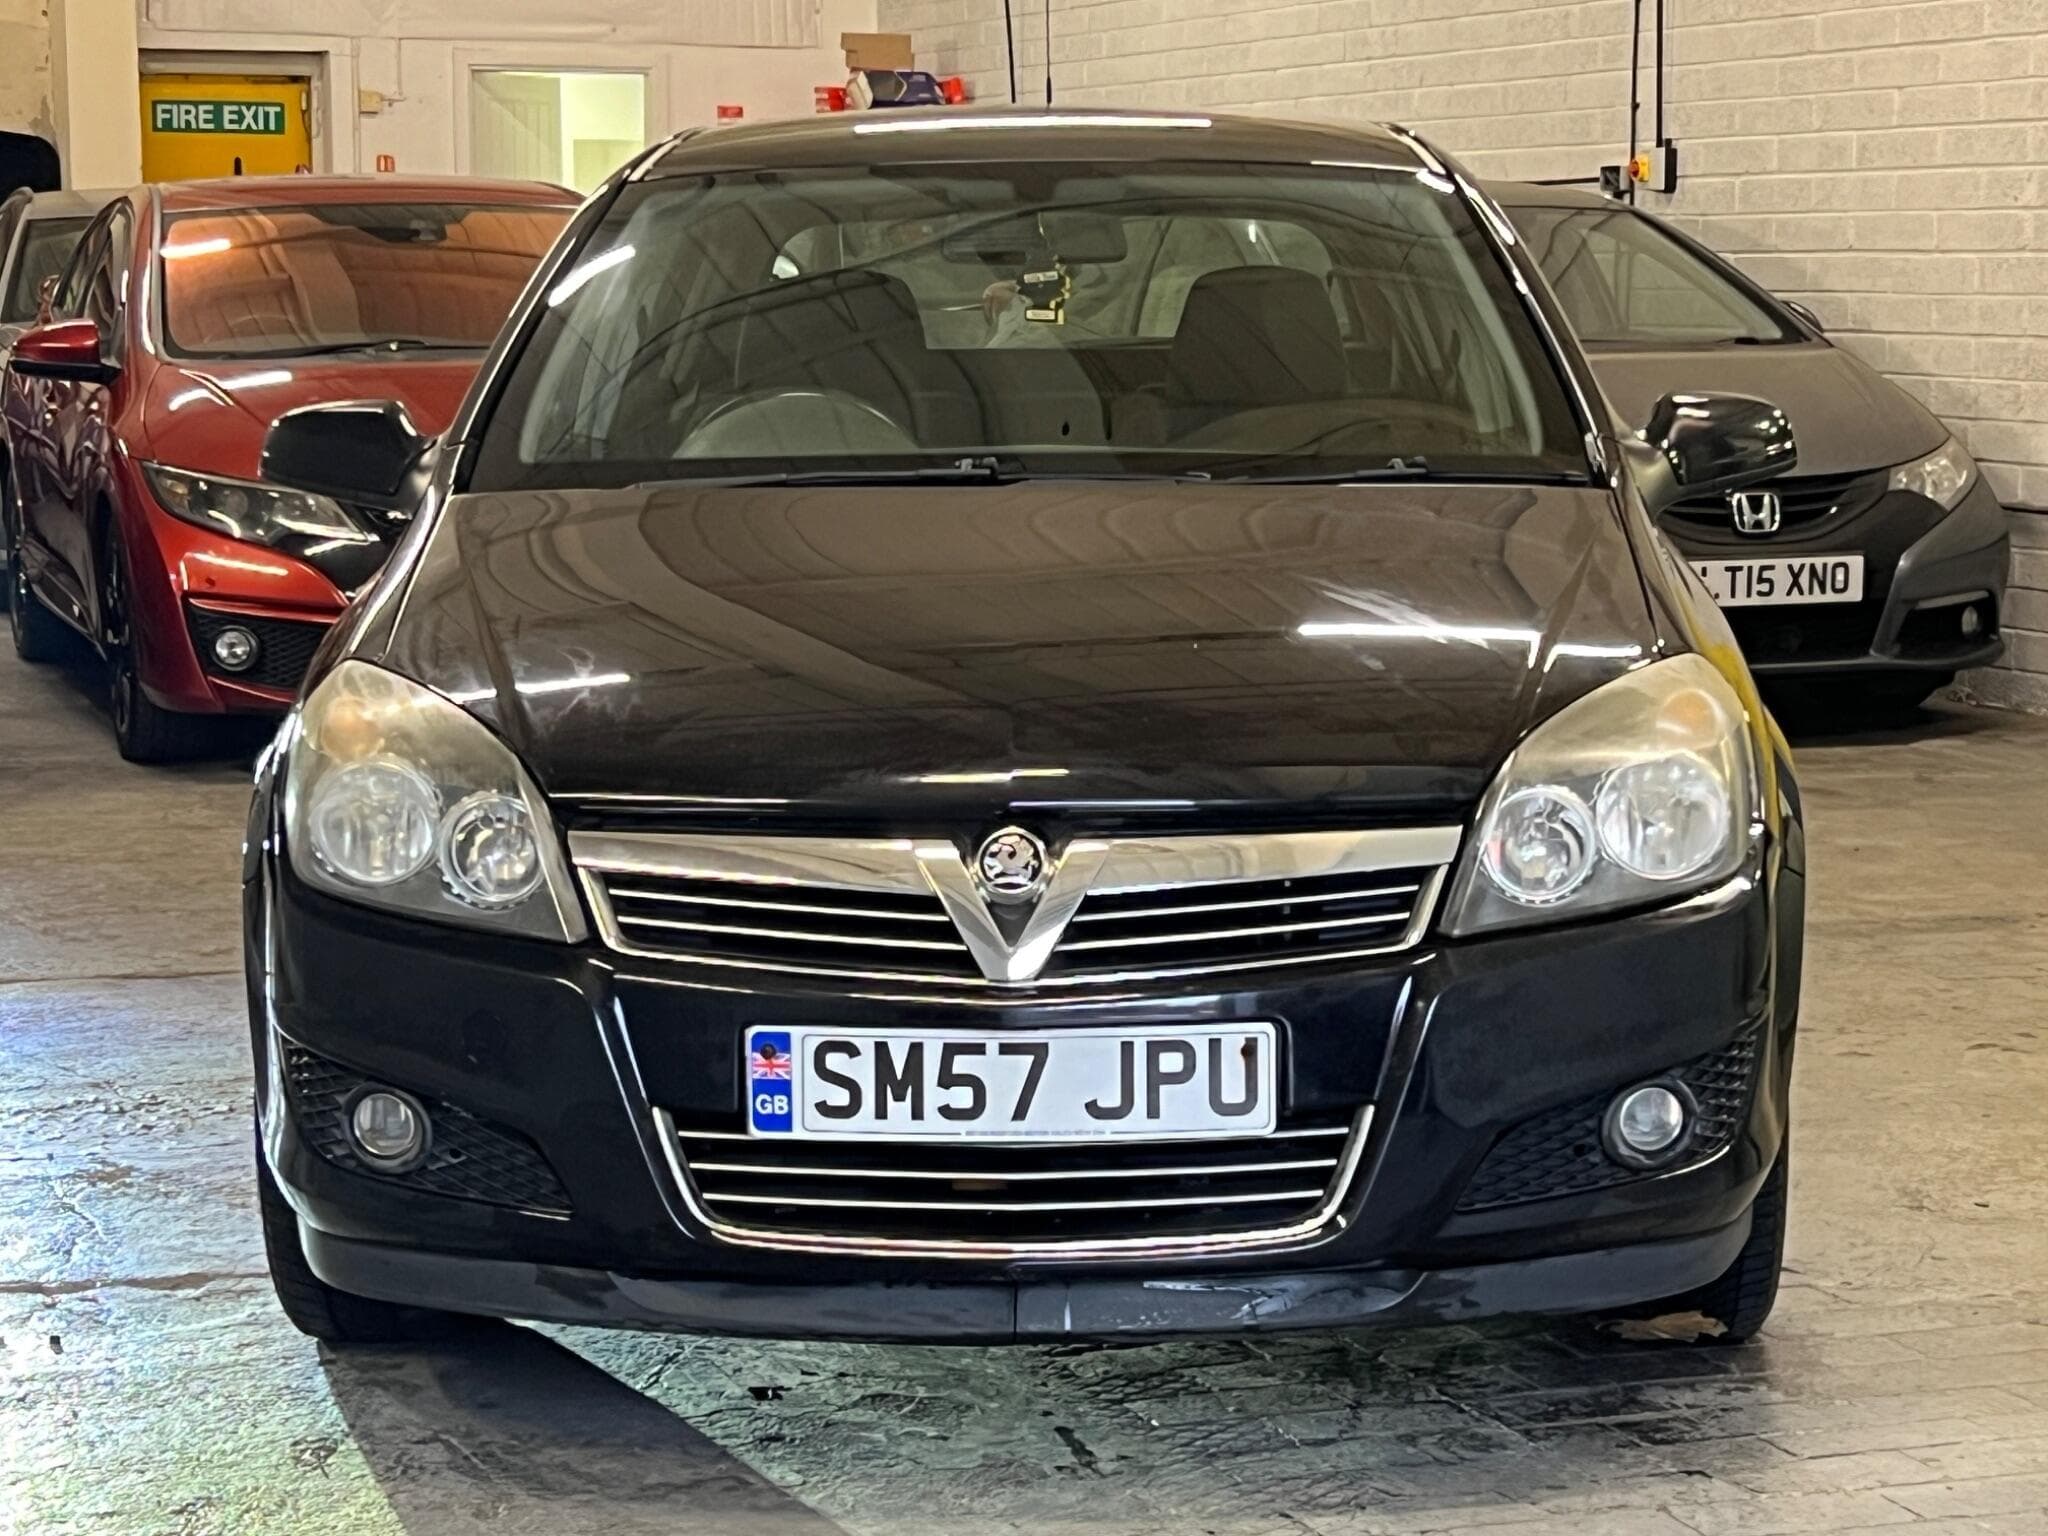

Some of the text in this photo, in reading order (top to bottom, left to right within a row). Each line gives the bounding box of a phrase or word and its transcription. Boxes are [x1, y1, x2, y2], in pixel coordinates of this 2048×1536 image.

[156, 103, 281, 131] FIRE EXIT
[1786, 562, 1850, 597] XNO
[813, 1037, 1259, 1121] SM57 JPU
[755, 1093, 789, 1115] GB
